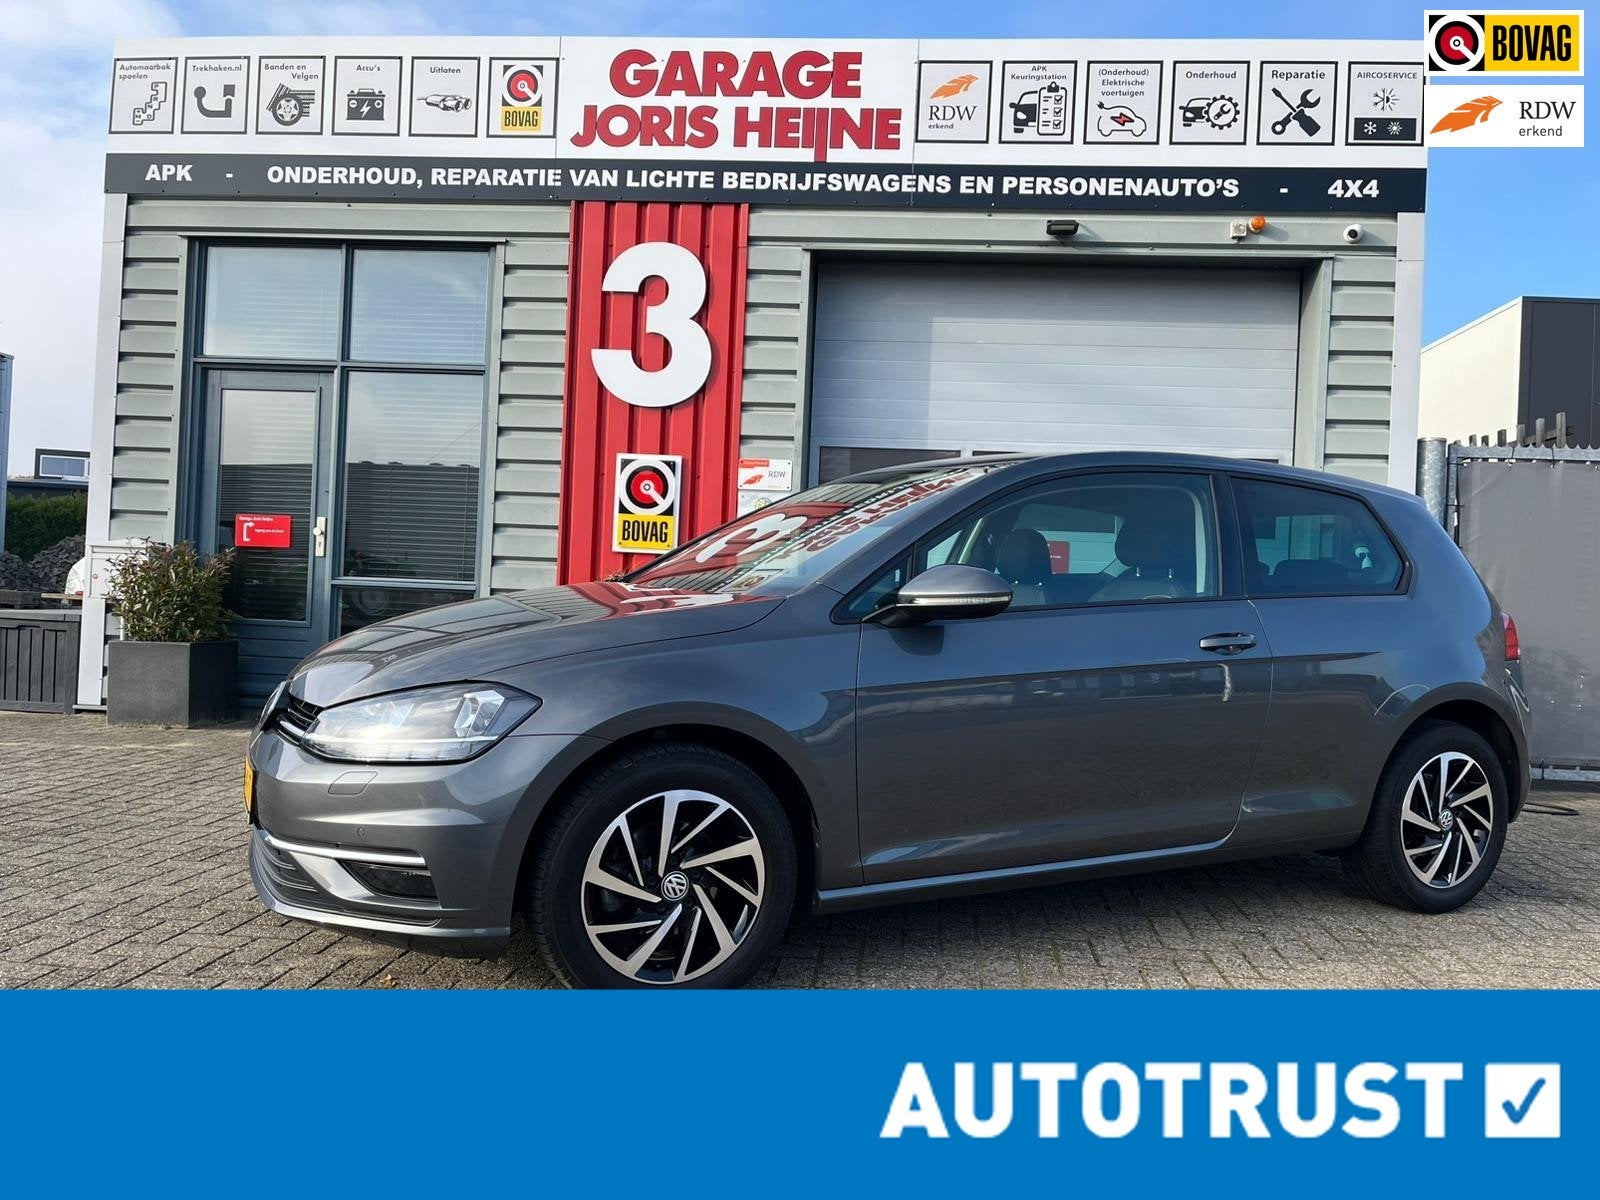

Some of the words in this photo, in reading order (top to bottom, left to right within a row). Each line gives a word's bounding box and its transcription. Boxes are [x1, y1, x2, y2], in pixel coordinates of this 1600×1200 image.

[191, 63, 243, 73] Trekhaken.nl
[264, 63, 295, 71] Banden
[355, 64, 381, 72] Accu's
[429, 66, 461, 74] Uitlaten
[291, 72, 319, 81] Velgen
[609, 49, 862, 99] GARAGE
[1098, 68, 1150, 77] (Onderhoud)
[1185, 70, 1237, 79] Onderhoud
[1271, 69, 1326, 81] Reparatie
[1356, 71, 1418, 80] AIRCOSERVICE
[1010, 73, 1067, 82] Keuringstation
[1101, 78, 1145, 87] Elektrische
[1101, 88, 1145, 98] voertuigen
[928, 105, 977, 121] RDW
[503, 110, 539, 127] BOVAG
[928, 122, 955, 130] erkend
[570, 104, 719, 148] JORIS
[733, 106, 902, 163] HEIJNE
[145, 164, 193, 181] APK
[267, 165, 422, 188] ONDERHOUD,
[431, 168, 562, 187] REPARATIE
[569, 169, 619, 187] VAN
[626, 170, 715, 189] LICHTE
[722, 171, 952, 193] BEDRIJFSWAGENS
[959, 175, 994, 194] EN
[1327, 179, 1380, 198] 4X4
[591, 241, 712, 408] 3
[768, 470, 786, 478] RDW
[621, 518, 669, 544] BOVAG
